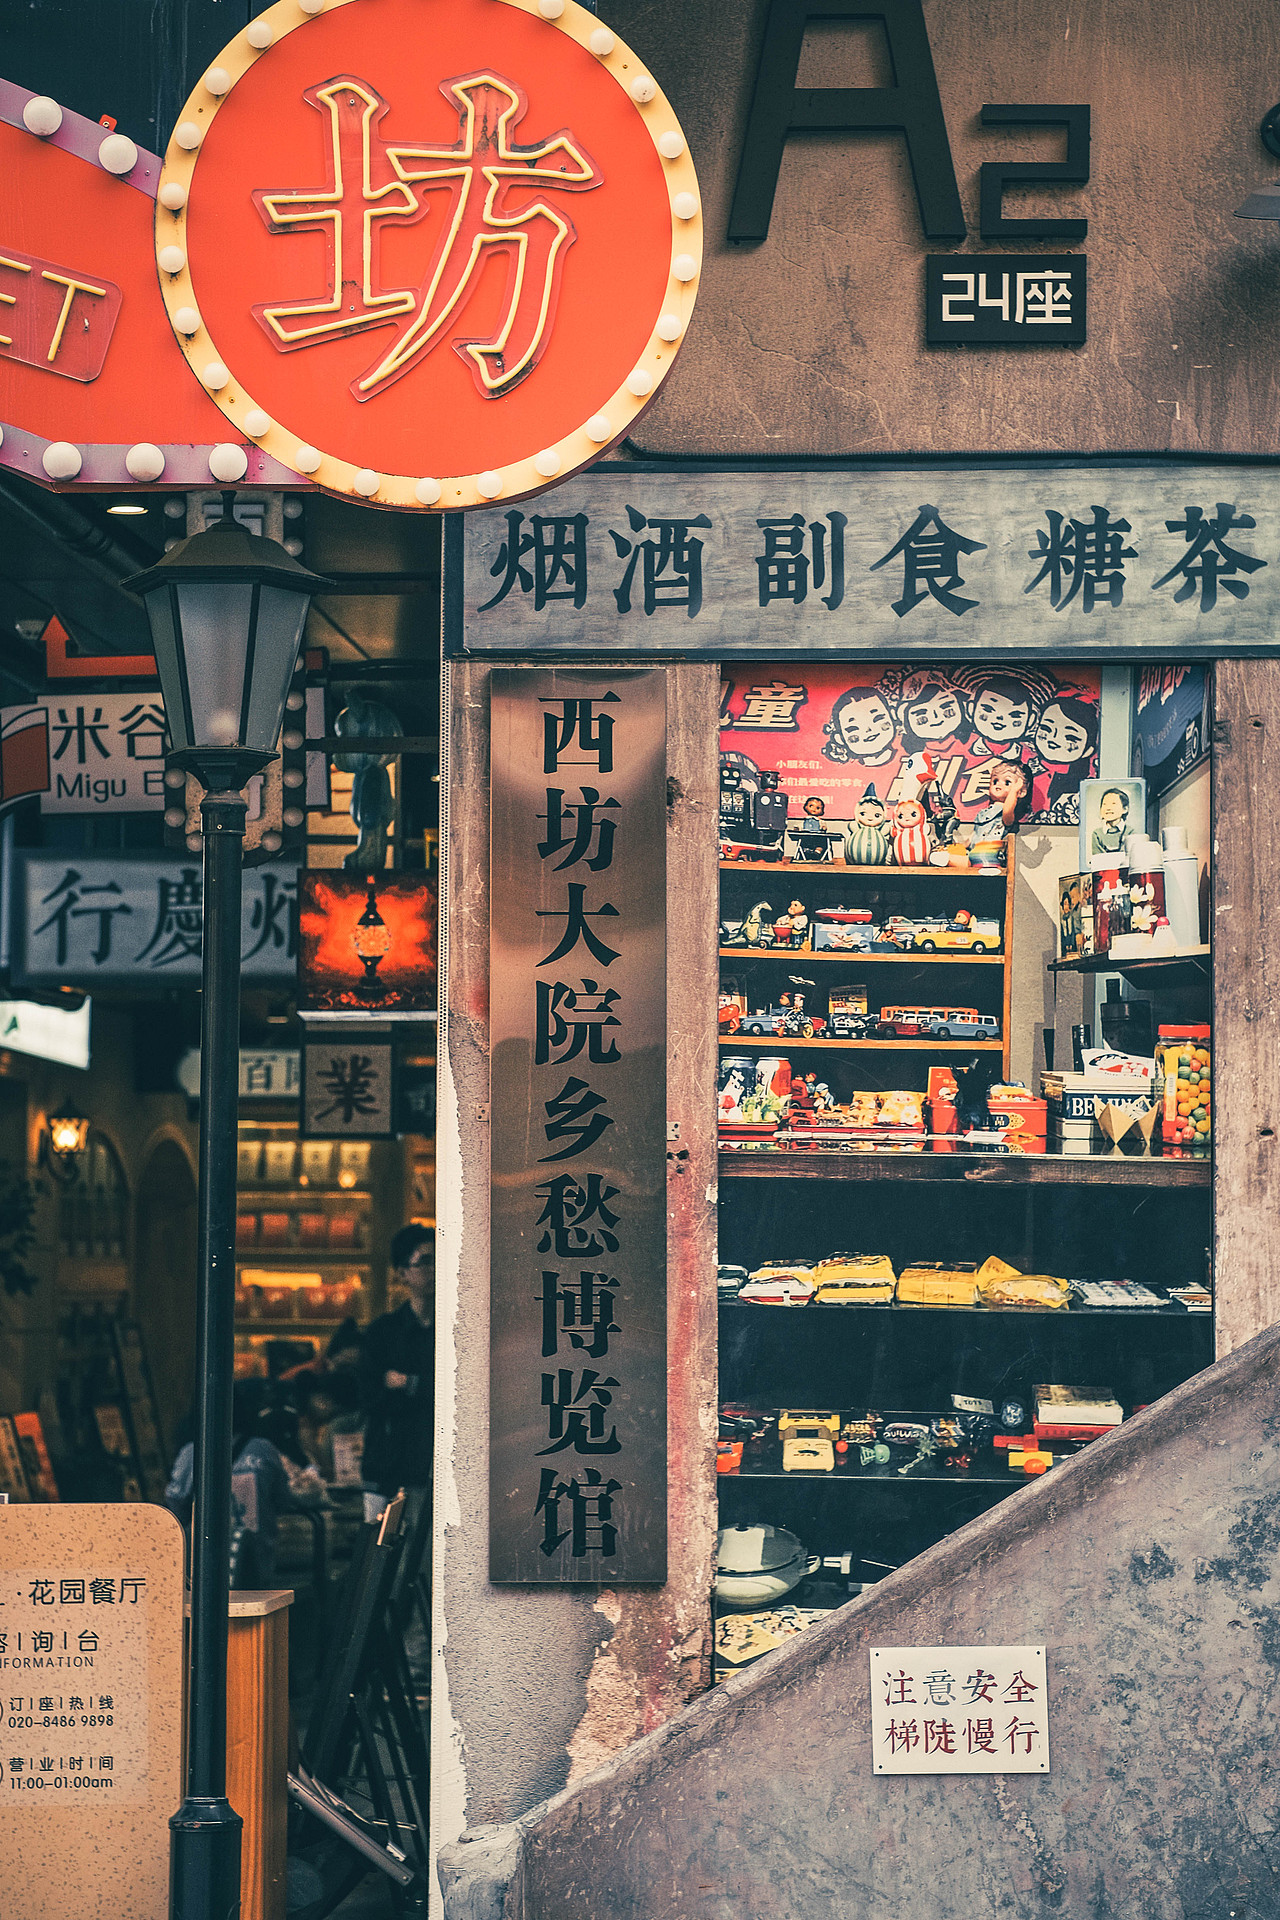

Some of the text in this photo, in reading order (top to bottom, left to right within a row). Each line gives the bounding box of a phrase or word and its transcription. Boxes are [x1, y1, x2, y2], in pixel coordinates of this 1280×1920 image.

[260, 73, 595, 392] 坊
[941, 269, 1073, 325] 24座
[476, 503, 1268, 619] 烟酒副食糖茶
[52, 704, 165, 764] 米谷
[57, 773, 126, 803] Migu
[534, 690, 623, 1558] 西坊大院乡愁博览馆
[0, 1656, 94, 1669] FORMATION
[882, 1669, 1039, 1707] 注意安全
[80, 1714, 115, 1727] 9898
[883, 1715, 1040, 1755] 梯陡慢行
